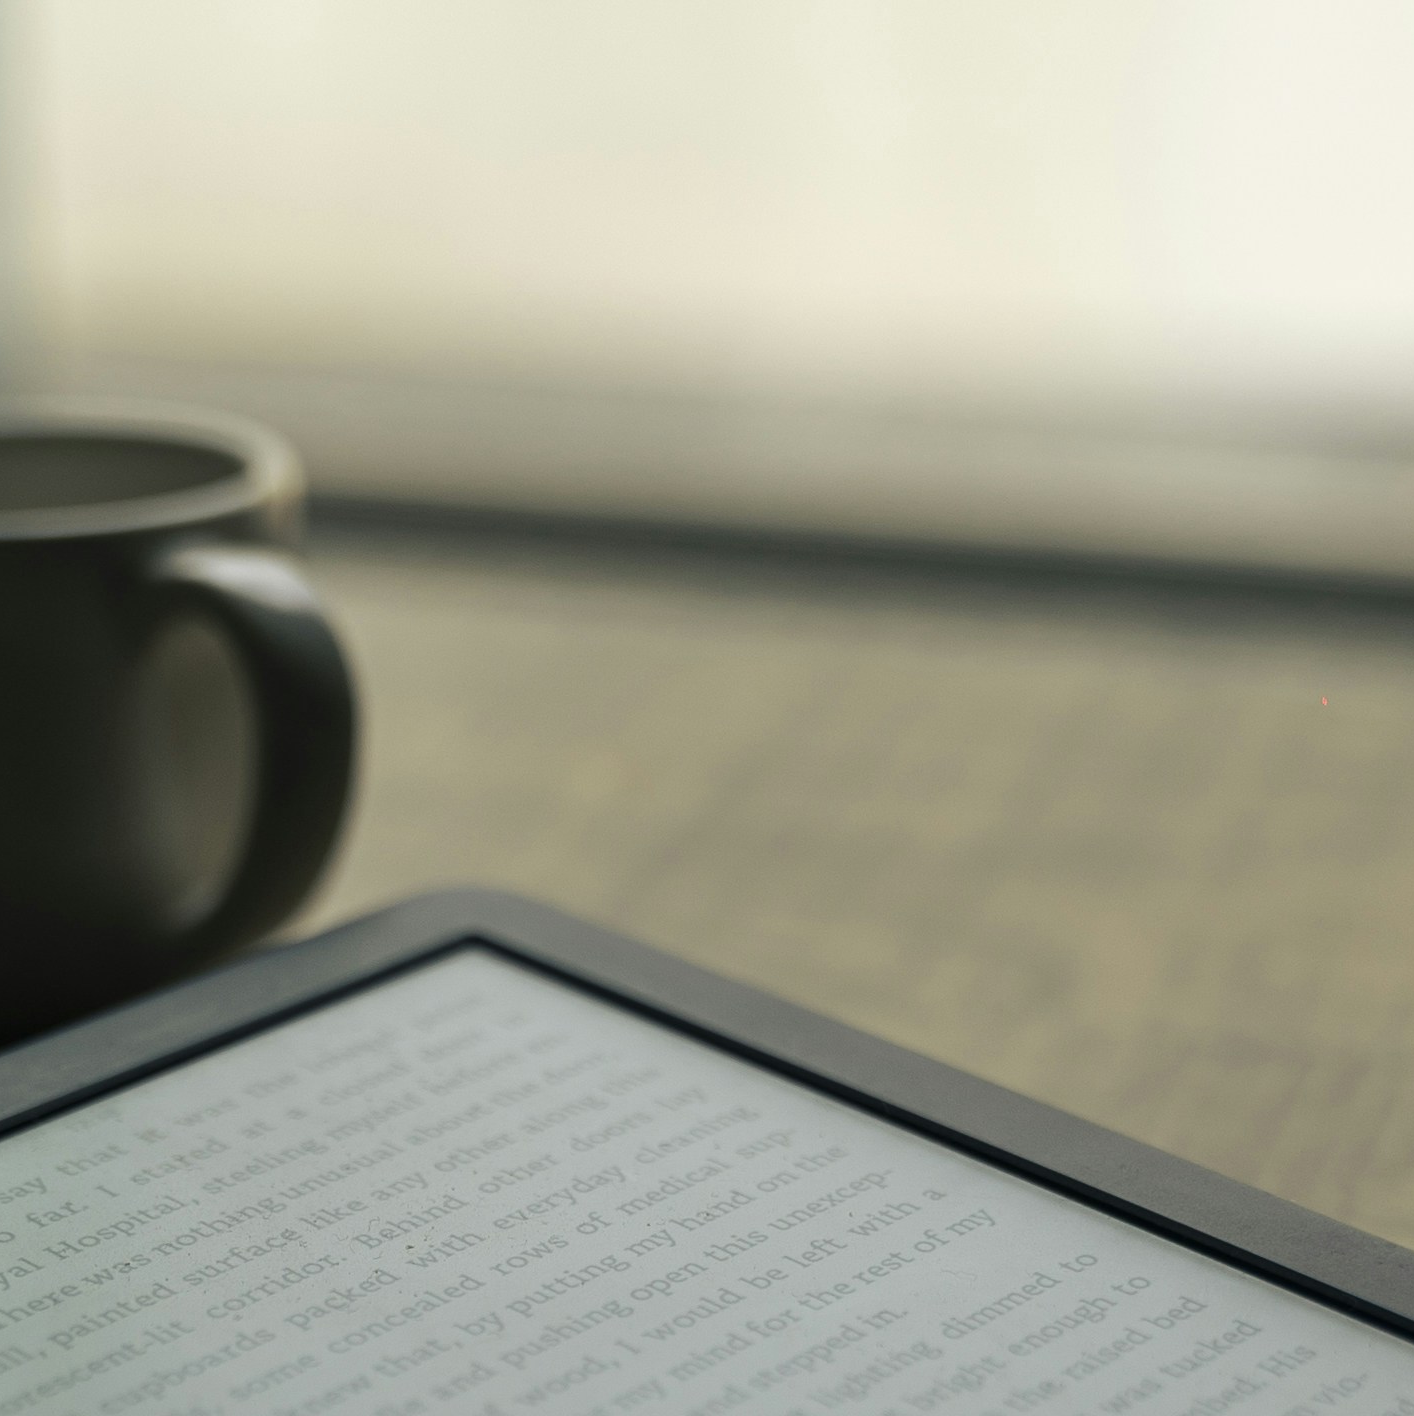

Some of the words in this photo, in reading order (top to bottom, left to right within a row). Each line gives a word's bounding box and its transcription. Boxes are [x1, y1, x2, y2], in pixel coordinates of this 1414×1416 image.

[24, 1203, 88, 1228] far.
[93, 1183, 121, 1197] I
[129, 1137, 231, 1185] stared
[239, 1121, 275, 1138] at
[283, 1109, 309, 1119] a
[317, 1061, 413, 1105] closed
[42, 1194, 200, 1260] Hospital,
[201, 1137, 328, 1194] steeling
[323, 1091, 425, 1140] myself
[56, 1144, 128, 1174] that
[132, 1128, 167, 1143] it
[173, 1098, 240, 1126] was
[242, 1074, 301, 1097] the
[82, 1253, 151, 1283] was
[150, 1195, 286, 1256] nothing
[278, 1140, 405, 1198] unusual
[403, 1103, 493, 1144] about
[486, 1082, 544, 1105] the
[46, 1282, 178, 1349] painted
[182, 1229, 302, 1286] surface
[296, 1200, 368, 1230] like
[370, 1171, 427, 1200] any
[434, 1133, 514, 1171] other
[518, 1093, 606, 1133] along
[100, 1327, 277, 1413] cupboards
[283, 1267, 402, 1331] packed
[406, 1232, 485, 1266] with
[492, 1164, 625, 1228] everyday
[633, 1105, 758, 1162] cleaning
[206, 1254, 348, 1317] corridor.
[349, 1193, 469, 1249] Behind
[477, 1153, 558, 1193] other
[565, 1111, 651, 1150] doors
[228, 1354, 321, 1402] some
[327, 1273, 485, 1352] concealed
[488, 1235, 568, 1275] rows
[575, 1210, 613, 1233] of
[613, 1156, 732, 1215] medical
[732, 1129, 790, 1158] sup-
[372, 1338, 464, 1376] that,
[450, 1311, 505, 1335] by
[505, 1253, 630, 1317] putting
[623, 1228, 676, 1256] my
[665, 1188, 755, 1230] hand
[755, 1172, 798, 1191] on
[791, 1146, 847, 1170] the
[429, 1361, 498, 1399] and
[497, 1298, 634, 1369] pushing
[628, 1262, 708, 1300] open
[701, 1229, 768, 1260] this
[766, 1168, 889, 1229] unexcep-
[512, 1354, 623, 1405] wood,
[611, 1338, 642, 1354] I
[642, 1286, 746, 1339] would
[735, 1268, 787, 1288] be
[778, 1238, 846, 1267] left
[845, 1201, 920, 1235] with
[920, 1189, 945, 1200] a
[608, 1378, 666, 1409] my
[665, 1331, 753, 1380] mind
[743, 1309, 800, 1337] for
[795, 1281, 855, 1309] the
[849, 1250, 913, 1284] rest
[912, 1228, 950, 1251] of
[943, 1208, 996, 1235] my
[746, 1323, 867, 1391] stepped
[853, 1309, 909, 1329] in.
[803, 1339, 943, 1408] lighting
[935, 1270, 1062, 1338] dimmed
[1056, 1253, 1098, 1271] to
[896, 1354, 1005, 1408] bright
[1005, 1296, 1116, 1354] enough
[1107, 1276, 1149, 1293] to
[999, 1379, 1063, 1409] the
[1059, 1325, 1152, 1379] raised
[1136, 1294, 1207, 1328] bed
[1096, 1377, 1162, 1412] was
[1154, 1318, 1262, 1376] tucked
[1252, 1345, 1317, 1377] His
[1309, 1372, 1366, 1403] vio-
